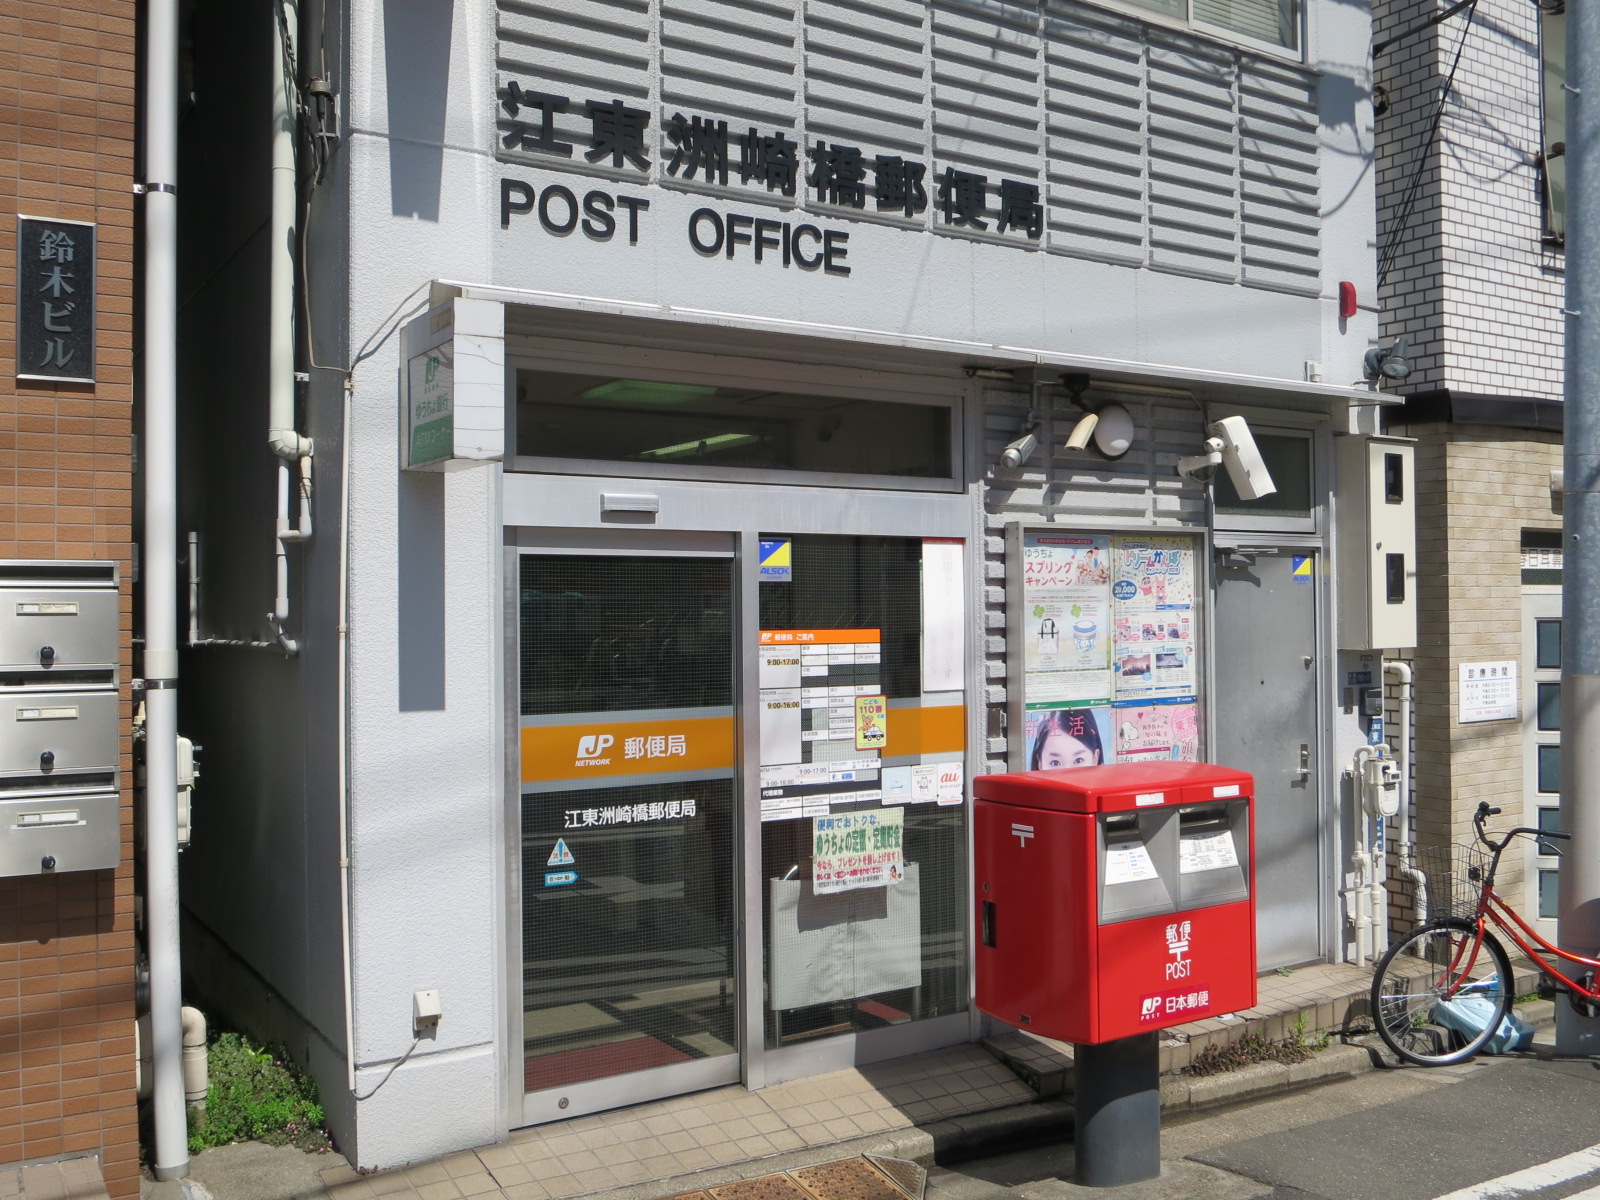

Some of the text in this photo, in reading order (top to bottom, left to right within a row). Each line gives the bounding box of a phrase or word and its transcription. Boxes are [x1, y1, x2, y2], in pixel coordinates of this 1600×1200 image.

[503, 81, 1044, 239] 江東洲崎橋郵便局
[500, 178, 851, 276] POST OFFICE
[39, 229, 76, 369] 鈴木ビル
[1024, 548, 1054, 559] ゆうちょ
[760, 567, 790, 575] ALSOK
[1025, 561, 1074, 574] スプリング
[1025, 576, 1073, 586] キャンペーン
[1468, 666, 1509, 679] 診療時間
[767, 701, 800, 709] 9:00-16:00
[860, 705, 883, 714] 110番
[624, 734, 687, 760] 郵便局
[575, 757, 611, 767] NETWORK
[940, 772, 959, 783] au
[564, 799, 697, 829] 江東洲崎橋郵便局
[1165, 920, 1192, 945] 郵便
[1165, 959, 1192, 981] POST
[1165, 990, 1209, 1013] 日本郵便
